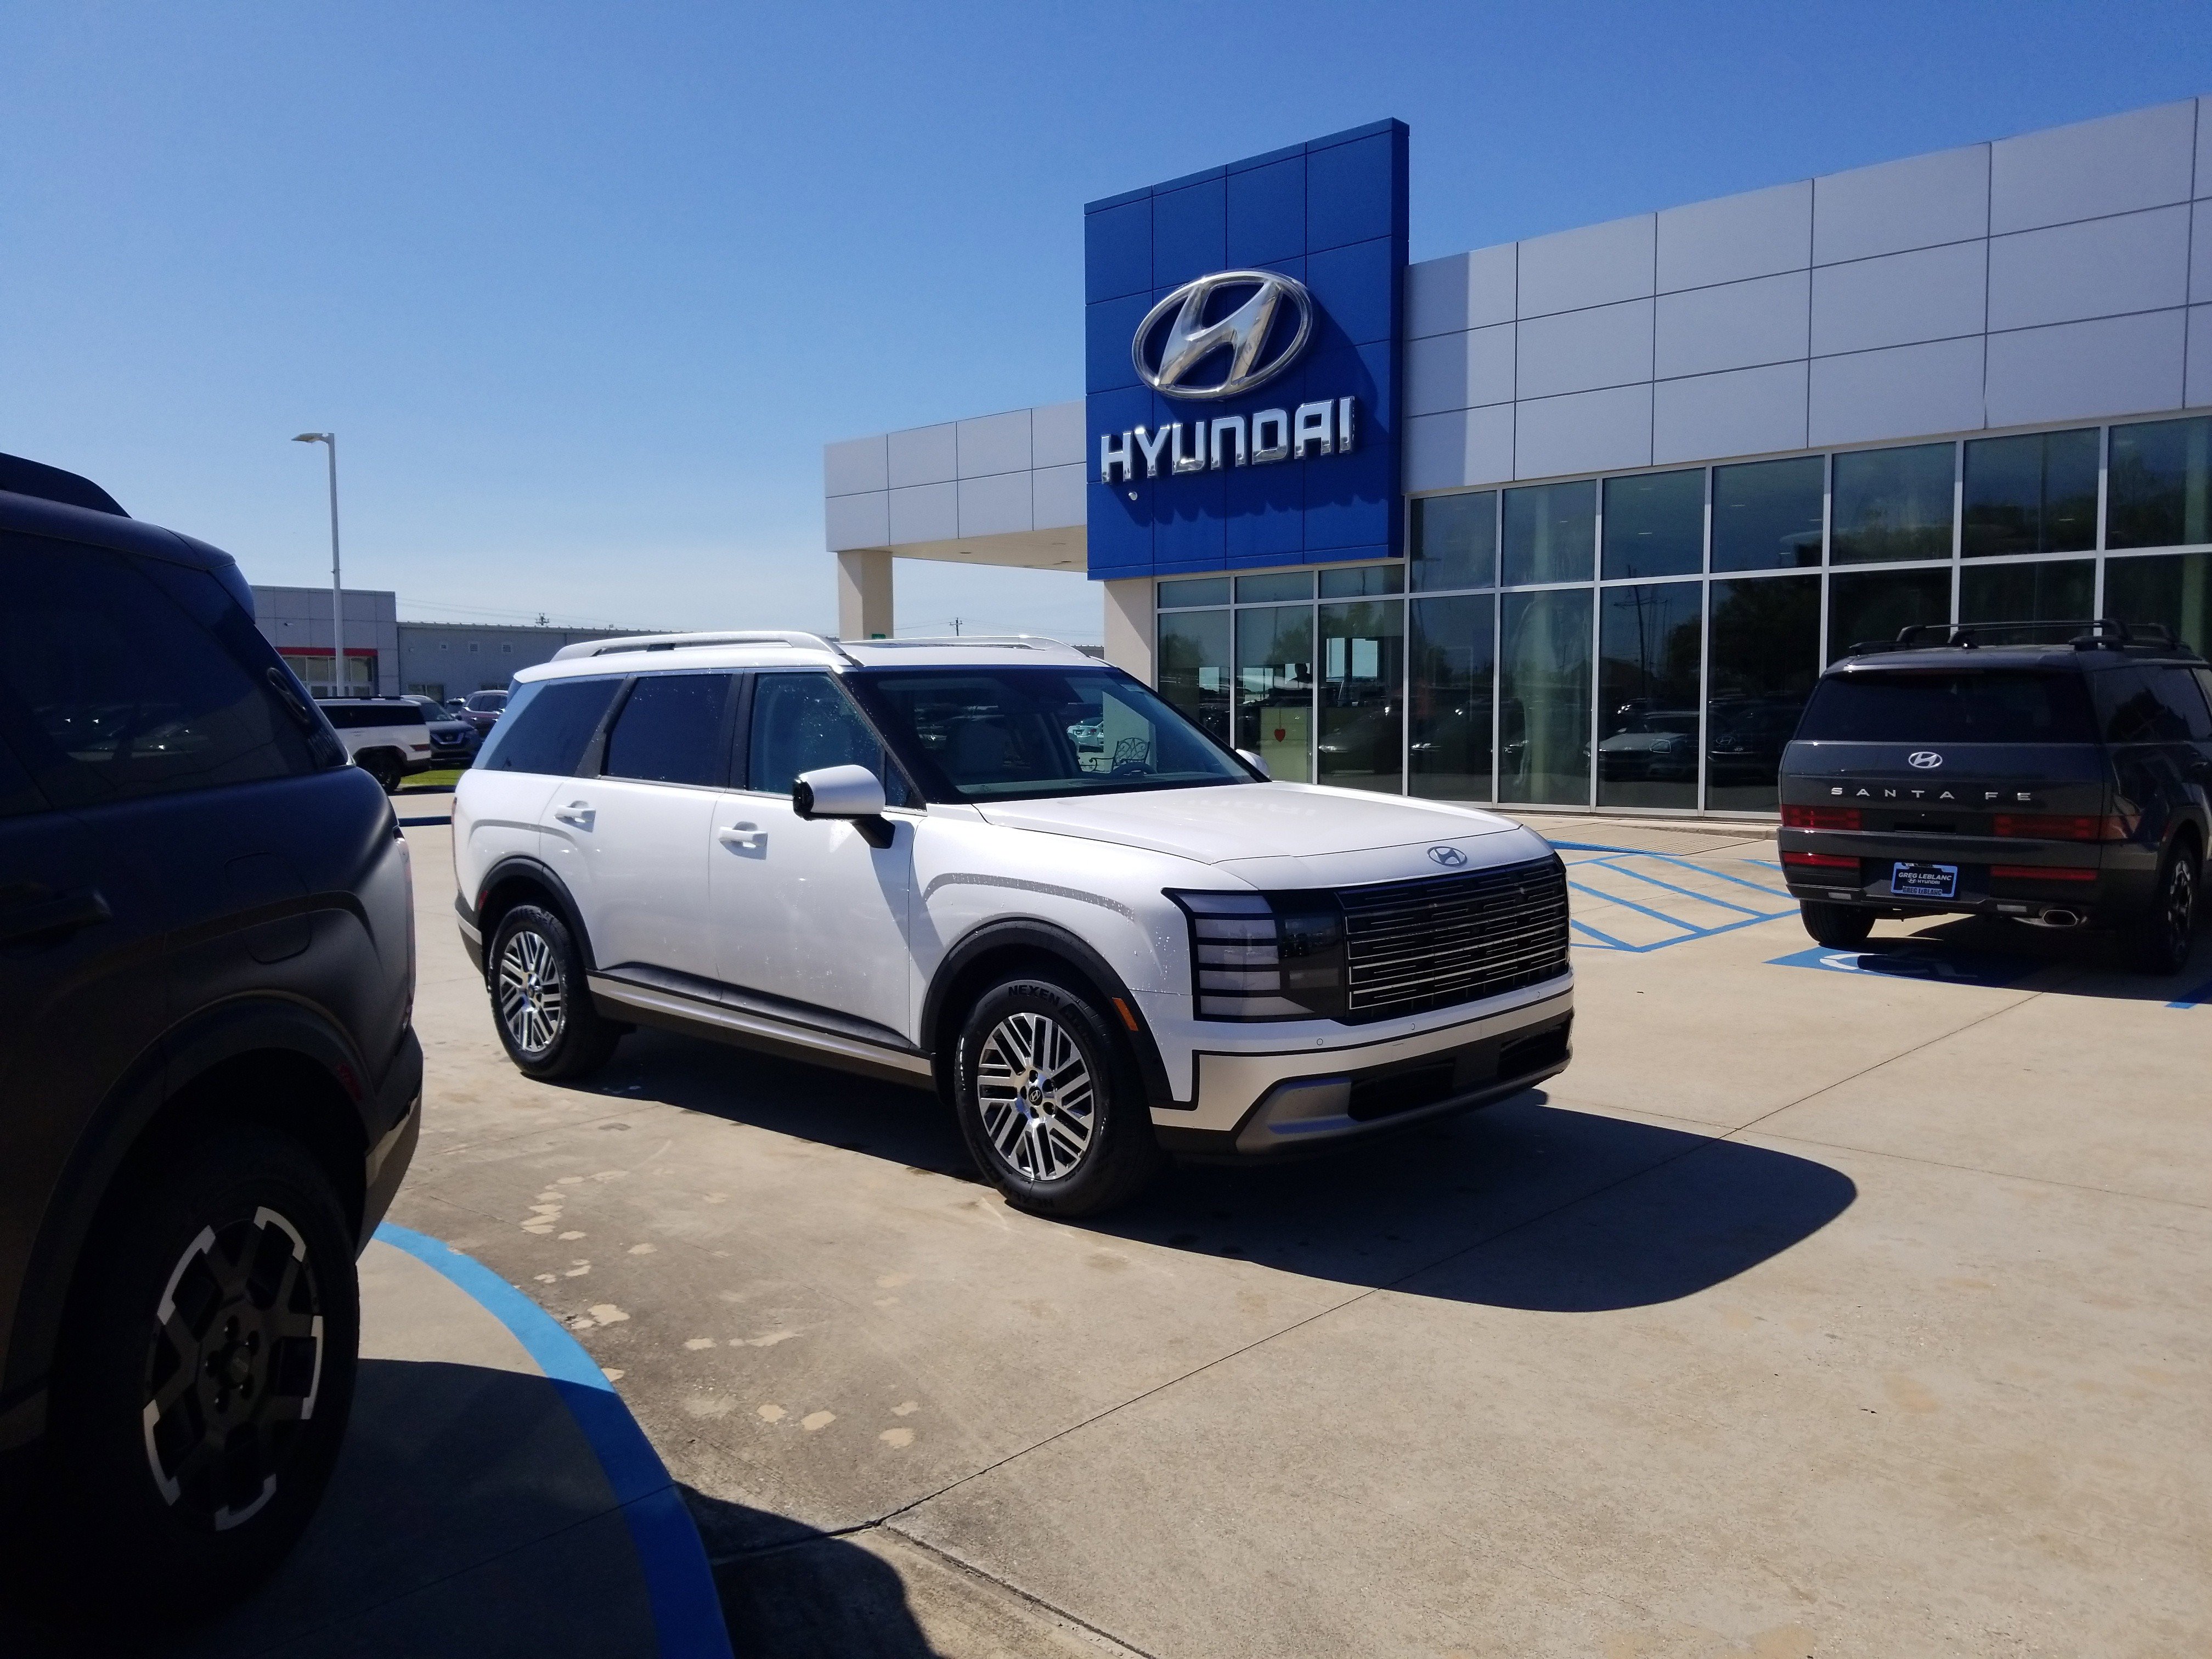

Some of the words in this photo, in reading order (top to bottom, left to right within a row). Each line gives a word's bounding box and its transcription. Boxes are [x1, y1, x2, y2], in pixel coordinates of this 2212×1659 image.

[1101, 396, 1355, 484] HYUNDAI
[1831, 787, 1955, 799] SANTA
[1985, 792, 2031, 800] FE
[1918, 873, 1952, 881] LEBLANC
[1008, 985, 1060, 1006] NEXEN
